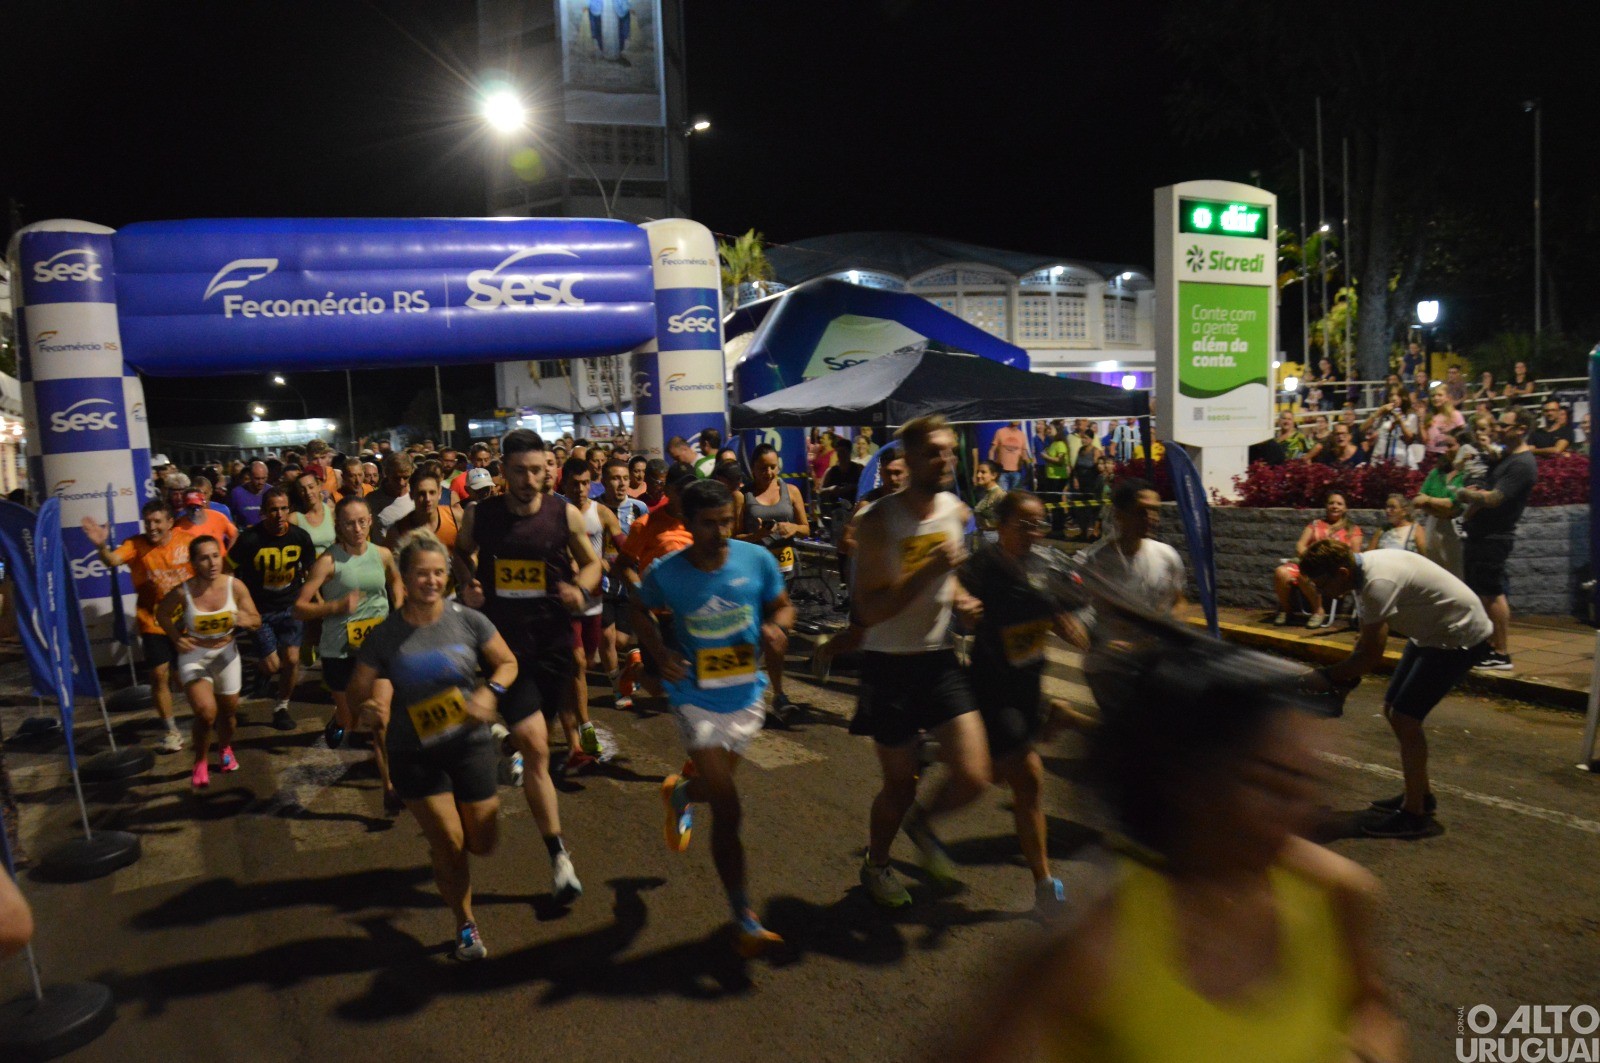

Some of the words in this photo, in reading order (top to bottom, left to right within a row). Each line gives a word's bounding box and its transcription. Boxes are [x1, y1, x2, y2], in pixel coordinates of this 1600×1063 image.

[33, 254, 103, 283] Sesc
[1208, 249, 1265, 273] Sicredi
[465, 256, 586, 312] Sesc
[223, 291, 386, 318] Fecomércio
[392, 290, 431, 314] RS
[1192, 304, 1229, 321] Conte
[1230, 309, 1257, 321] com
[1203, 322, 1239, 337] gente
[39, 341, 102, 352] Fecomércio
[104, 341, 118, 351] RS
[1192, 335, 1228, 353] além
[1230, 337, 1248, 353] da
[1192, 353, 1237, 368] conta.
[50, 404, 119, 434] Sesc
[780, 550, 793, 563] 62
[500, 566, 541, 584] 342
[353, 625, 376, 641] 34
